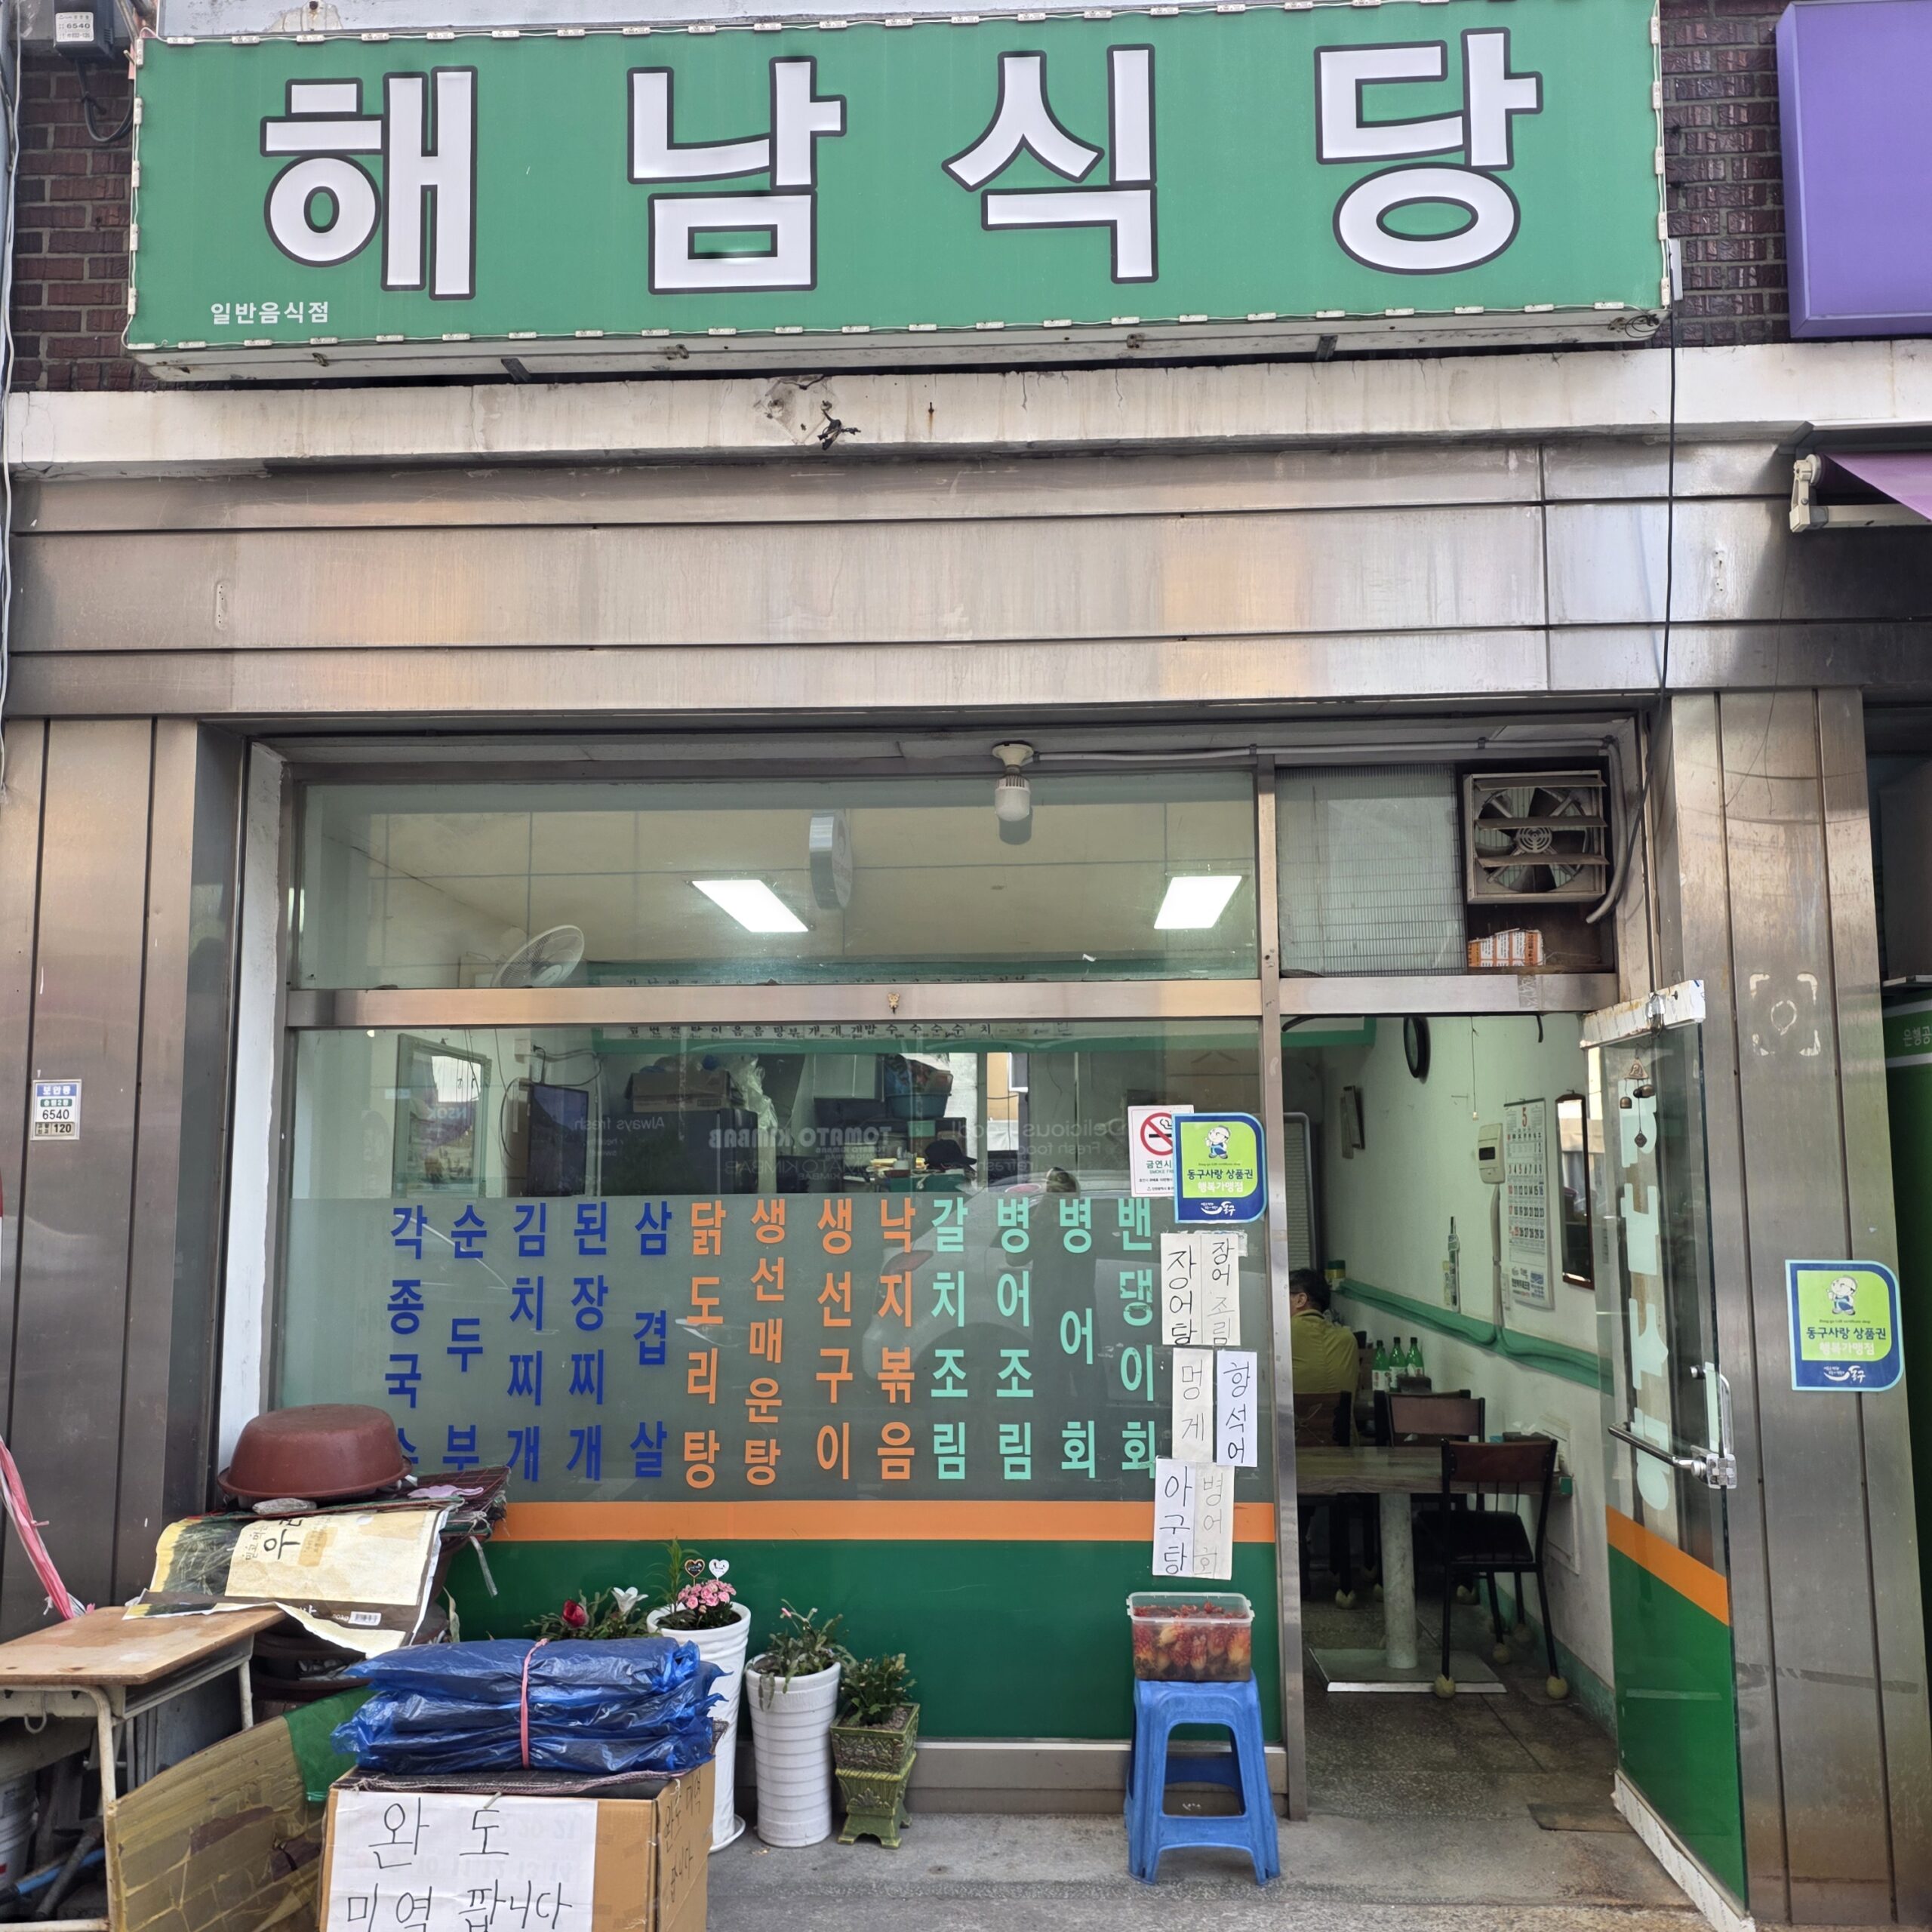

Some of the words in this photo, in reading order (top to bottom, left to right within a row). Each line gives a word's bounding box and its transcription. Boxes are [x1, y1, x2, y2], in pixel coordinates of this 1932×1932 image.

[260, 29, 1543, 300] 해남식당
[211, 301, 330, 325] 일반음식점
[42, 1109, 69, 1120] 6540
[54, 1123, 72, 1133] 120
[1146, 1160, 1172, 1169] 금연시
[1186, 1169, 1223, 1180] 동구사랑
[1226, 1169, 1254, 1180] 상품권
[1197, 1181, 1244, 1194] 행복가맹점
[1167, 1244, 1198, 1345] 장어탕
[1211, 1238, 1235, 1286] 장어
[444, 1203, 487, 1471] 순두부
[507, 1203, 547, 1482] 김치찌개
[567, 1201, 608, 1481] 된장찌개
[631, 1201, 672, 1478] 삼겹살
[684, 1200, 726, 1490] 닭도리탕
[745, 1198, 786, 1487] 생선매운탕
[816, 1198, 854, 1480] 생선구이
[877, 1198, 915, 1481] 낙지볶음
[931, 1198, 968, 1481] 갈치조림
[996, 1198, 1034, 1481] 병어조림
[1059, 1198, 1096, 1478] 병어회
[1118, 1198, 1156, 1479] 밴댕이회
[1208, 1296, 1235, 1346] 조림
[1806, 1327, 1850, 1340] 동구사랑
[1853, 1327, 1887, 1340] 상품권
[1819, 1342, 1875, 1356] 행복가맹점
[1182, 1359, 1204, 1441] 멍게
[1159, 1466, 1193, 1575] 아구탕
[368, 1796, 509, 1869] 완도
[347, 1882, 432, 1932] 미역
[457, 1879, 573, 1932] 팝니다
